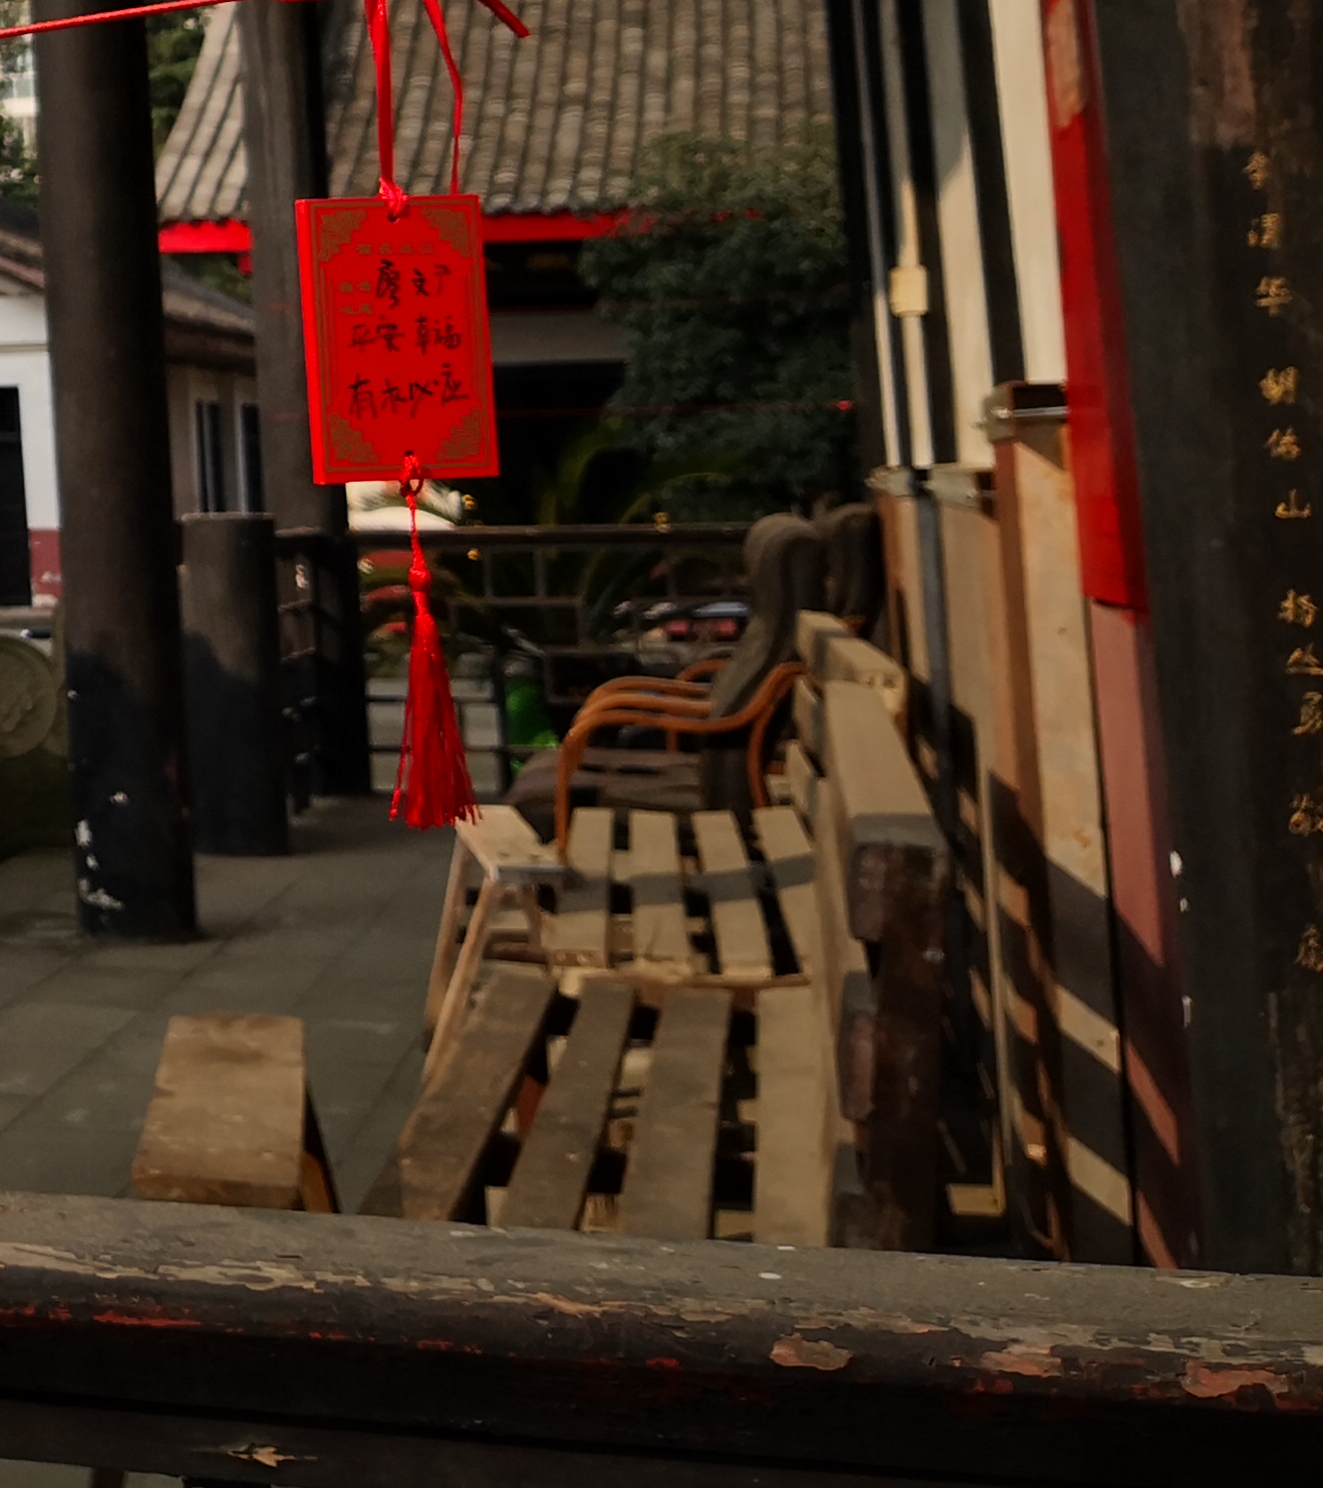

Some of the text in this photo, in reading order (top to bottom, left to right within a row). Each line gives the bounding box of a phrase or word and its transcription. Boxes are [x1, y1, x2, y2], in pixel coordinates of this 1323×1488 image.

[349, 313, 462, 355] 平安幸福
[348, 363, 470, 420] 有求必应
